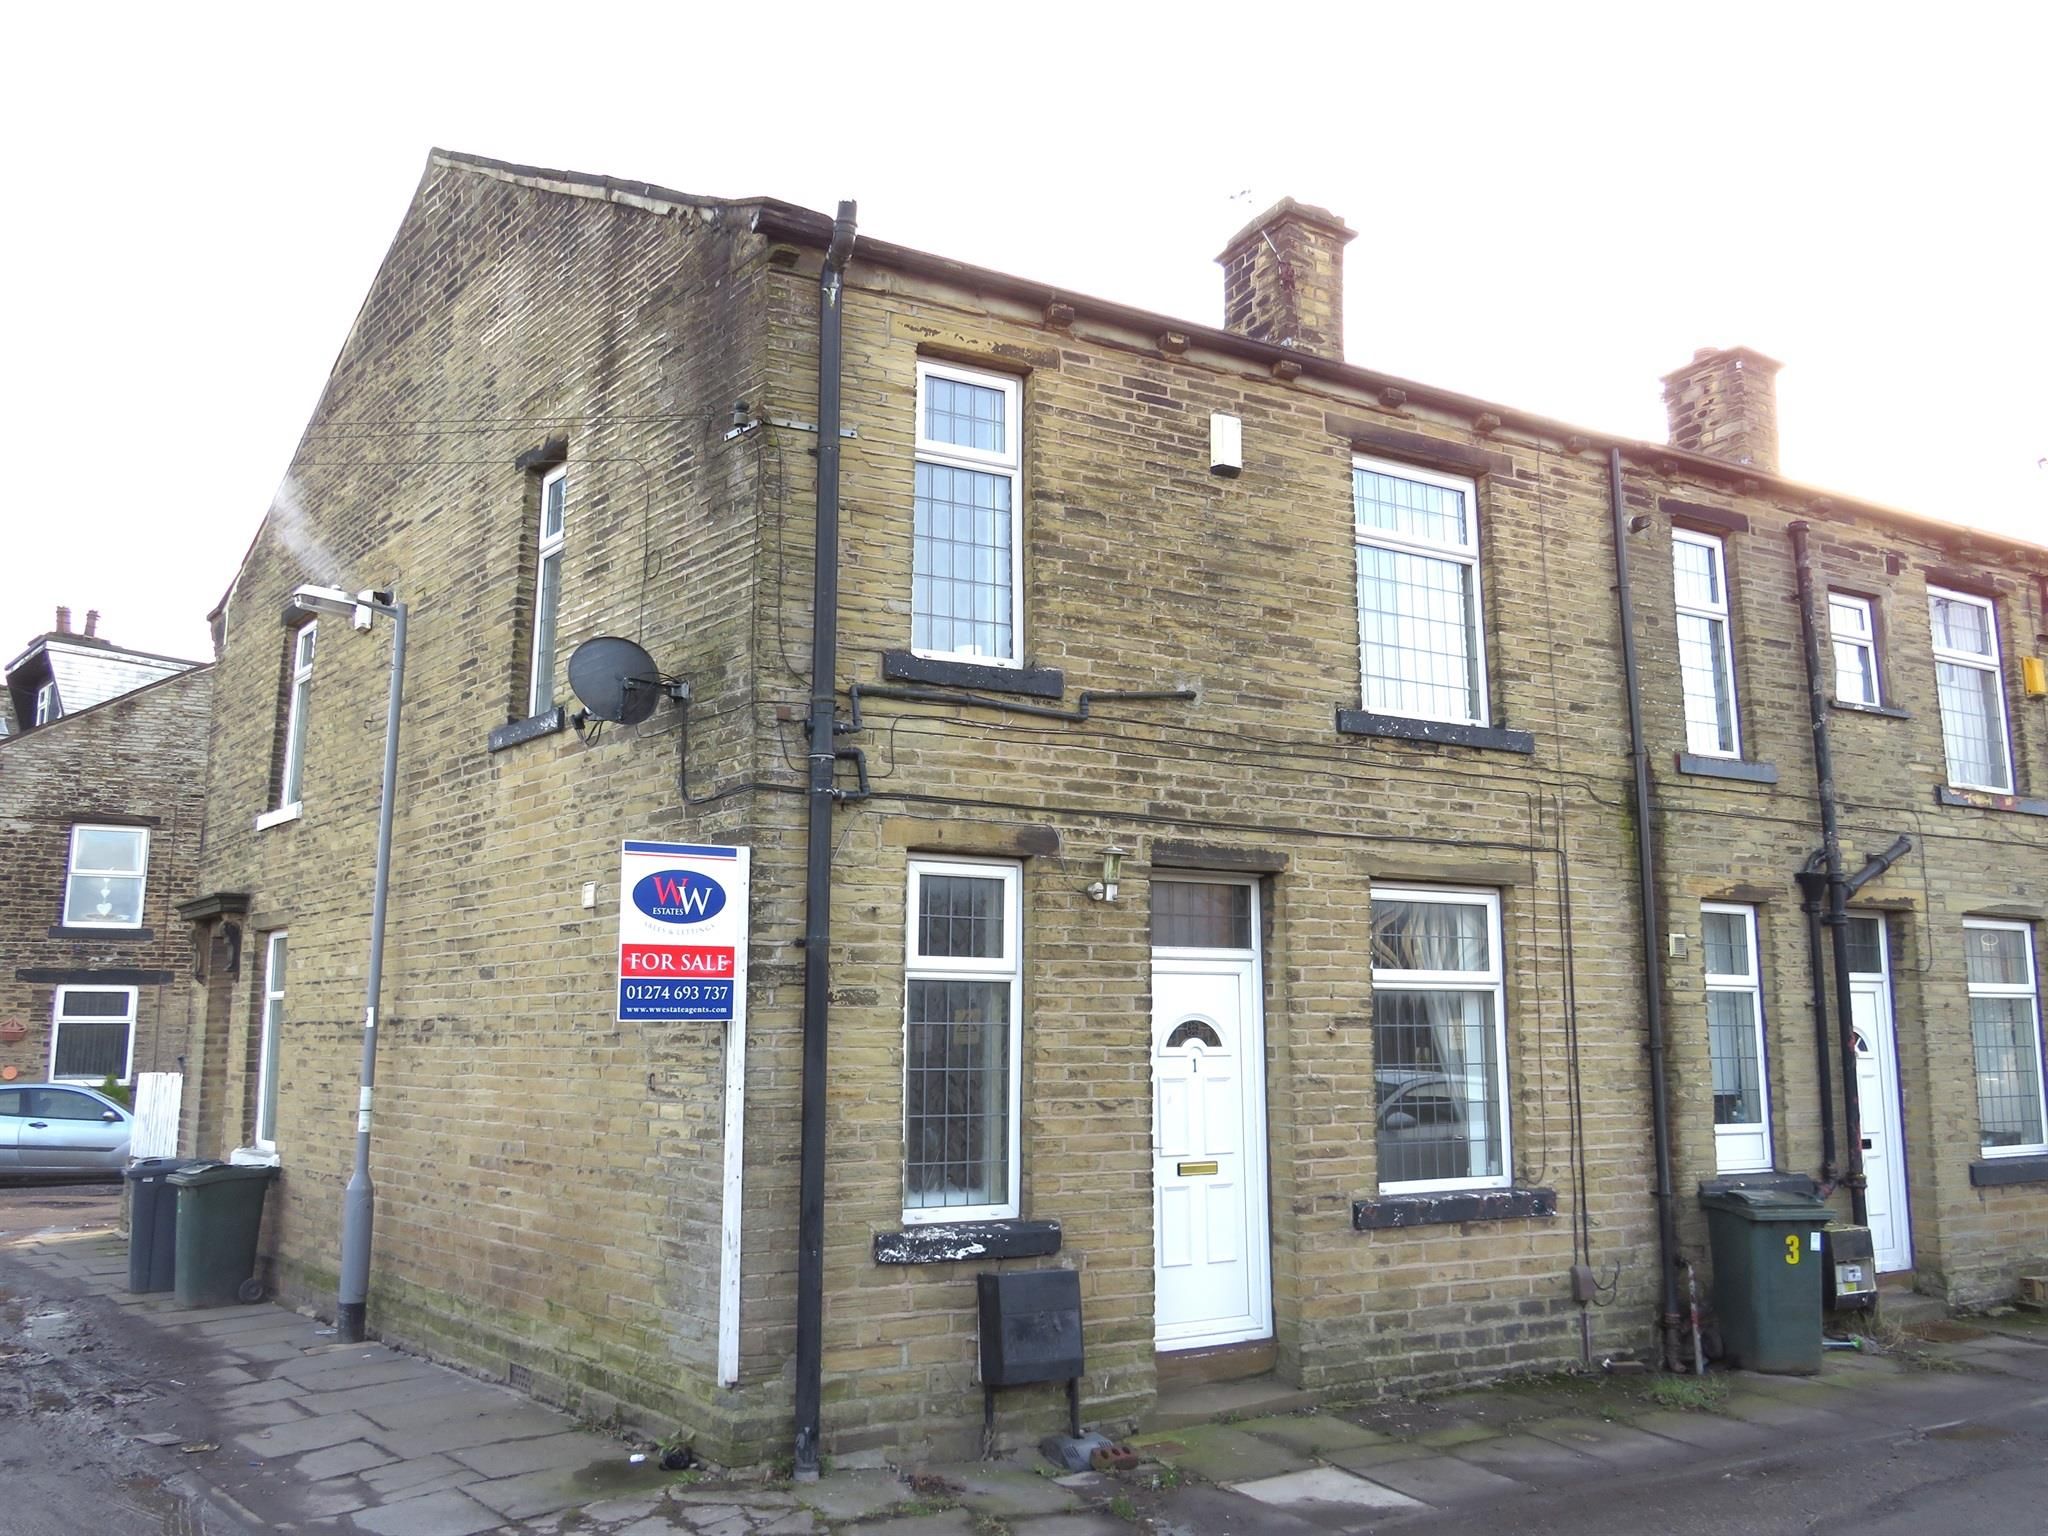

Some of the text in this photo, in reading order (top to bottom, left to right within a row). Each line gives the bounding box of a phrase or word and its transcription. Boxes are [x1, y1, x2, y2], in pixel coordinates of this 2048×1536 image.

[652, 907, 684, 916] ESTATES
[630, 952, 728, 972] FOR SALE
[626, 985, 729, 1001] 01274 693 737
[626, 1006, 728, 1015] www.wwestateagents.com
[1192, 1058, 1198, 1073] 1
[1785, 1234, 1800, 1265] 3
